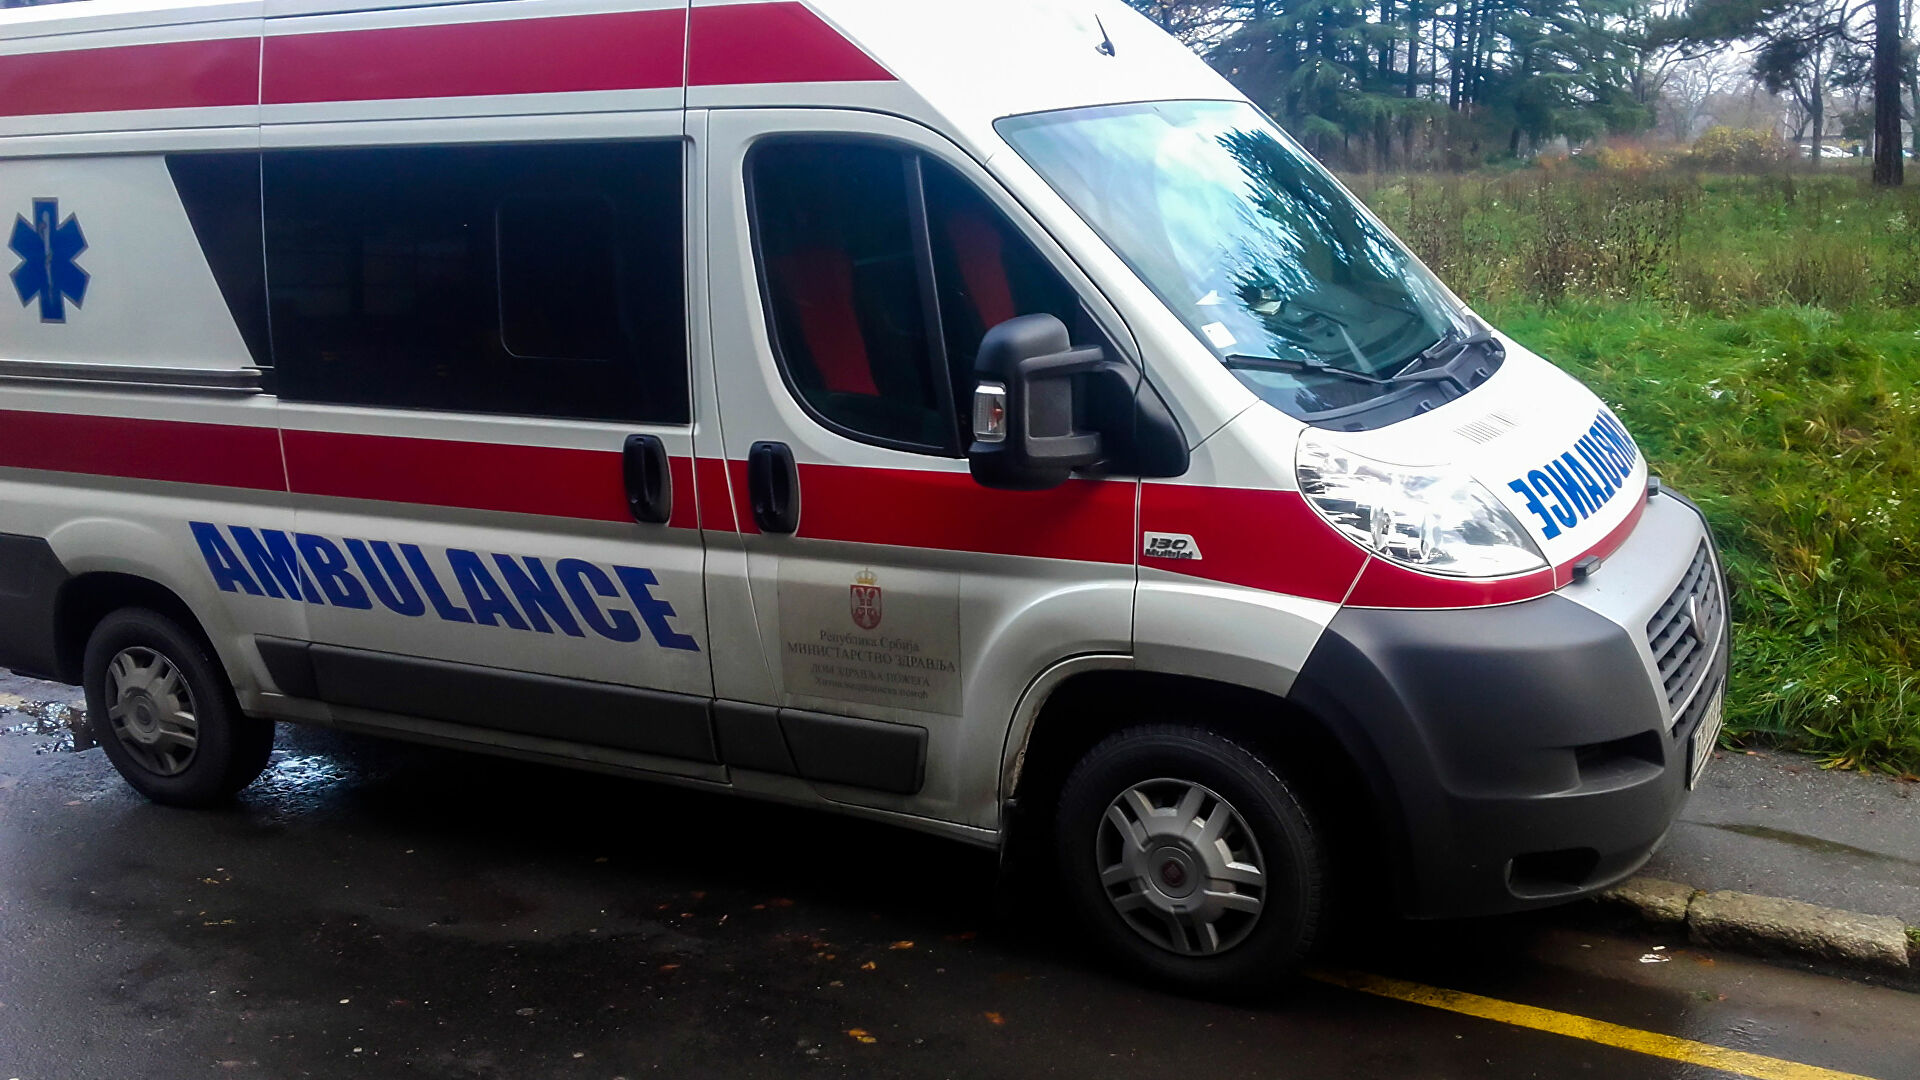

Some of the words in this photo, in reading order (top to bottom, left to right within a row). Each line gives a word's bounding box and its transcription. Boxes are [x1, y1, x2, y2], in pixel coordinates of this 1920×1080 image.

[1150, 538, 1187, 550] 130
[188, 521, 701, 652] AMBULANCE
[820, 630, 877, 648] Република
[880, 636, 920, 652] Србија
[787, 642, 892, 665] МИНИСТАРСТВО
[898, 655, 956, 673] ЗДРАВЉА
[811, 663, 834, 675] ДОМ
[838, 666, 883, 681] ЗДРАВЉА
[886, 671, 930, 687] ПОЖЕГА
